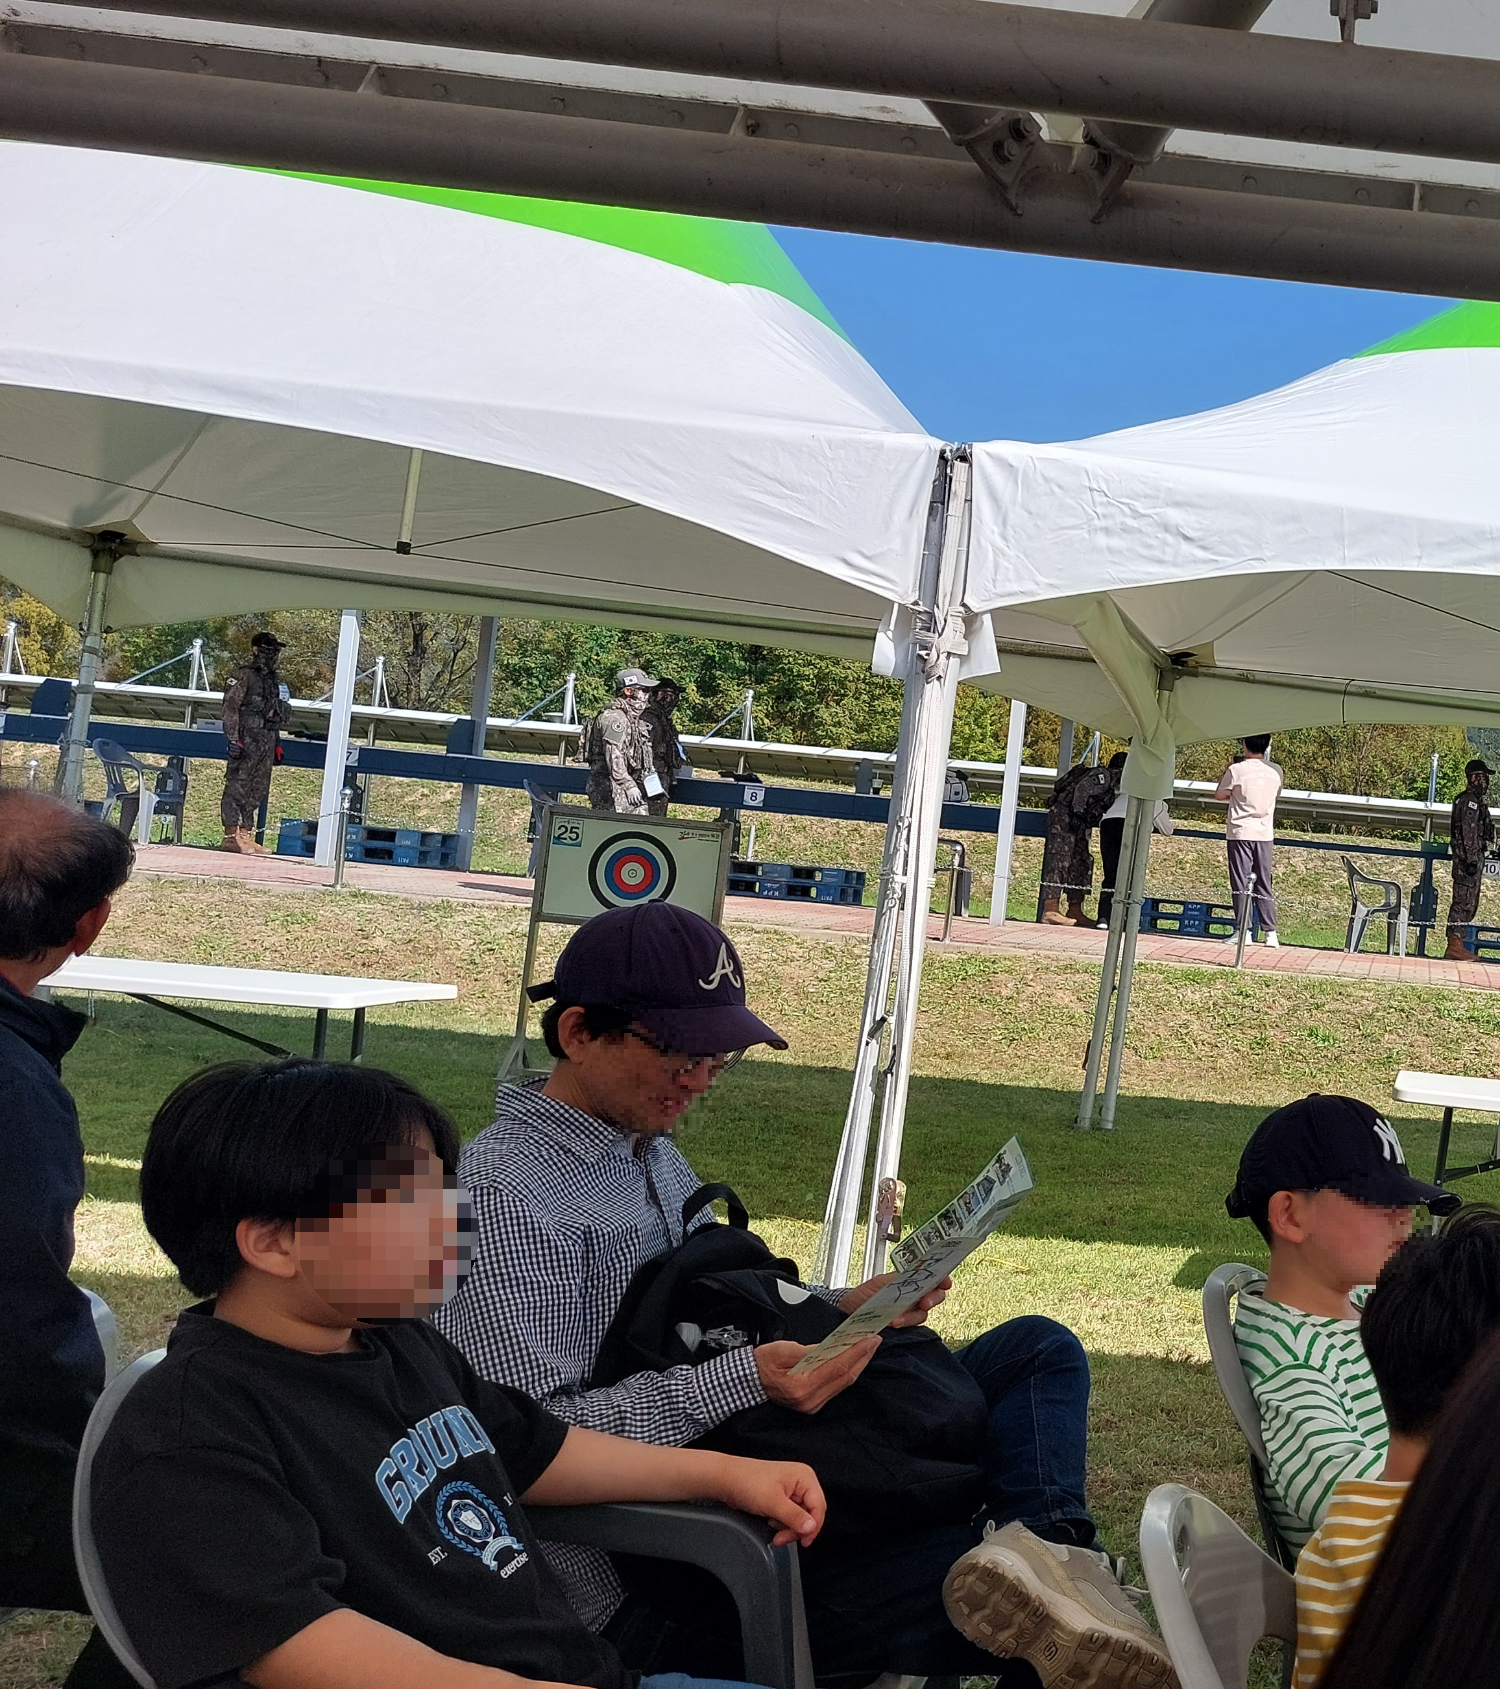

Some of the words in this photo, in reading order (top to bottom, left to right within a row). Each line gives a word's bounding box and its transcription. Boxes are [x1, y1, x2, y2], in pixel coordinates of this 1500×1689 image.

[346, 751, 352, 761] 7
[750, 791, 758, 802] 8
[557, 824, 580, 842] 25
[1484, 864, 1496, 874] 10
[698, 942, 742, 990] A
[427, 1546, 448, 1566] EST.
[500, 1551, 530, 1579] exercise
